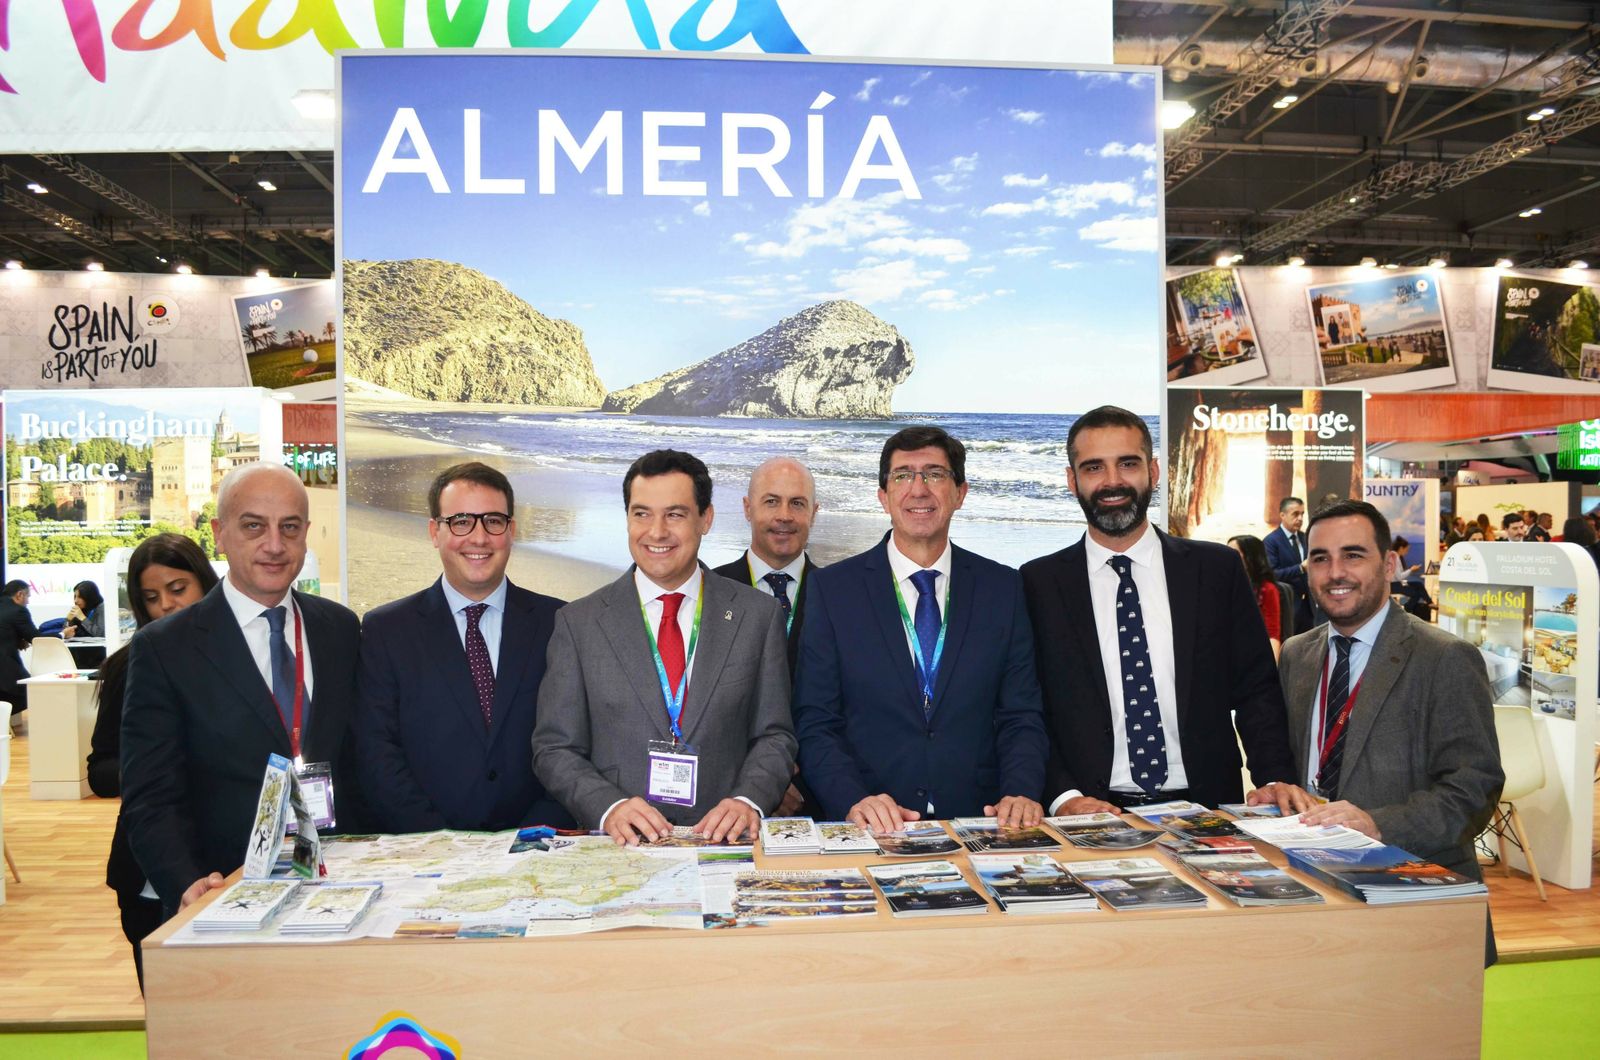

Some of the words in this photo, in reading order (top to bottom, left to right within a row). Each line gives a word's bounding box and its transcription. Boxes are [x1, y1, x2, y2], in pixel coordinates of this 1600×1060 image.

[362, 91, 924, 200] ALMERÍA
[41, 361, 53, 380] IS
[54, 347, 104, 383] PART
[102, 351, 121, 370] OF
[120, 339, 157, 374] YOU
[20, 410, 214, 444] Buckingham
[1192, 404, 1356, 439] Stonehenge.
[20, 454, 128, 482] Palace.
[313, 451, 337, 467] LIFE
[1496, 554, 1534, 563] PALLADIUM
[1535, 555, 1558, 564] HOTEL
[1501, 565, 1521, 575] COSTA
[1522, 566, 1536, 575] DEL
[1445, 587, 1479, 605] Costa
[1482, 590, 1502, 607] del
[1505, 592, 1526, 609] Sol
